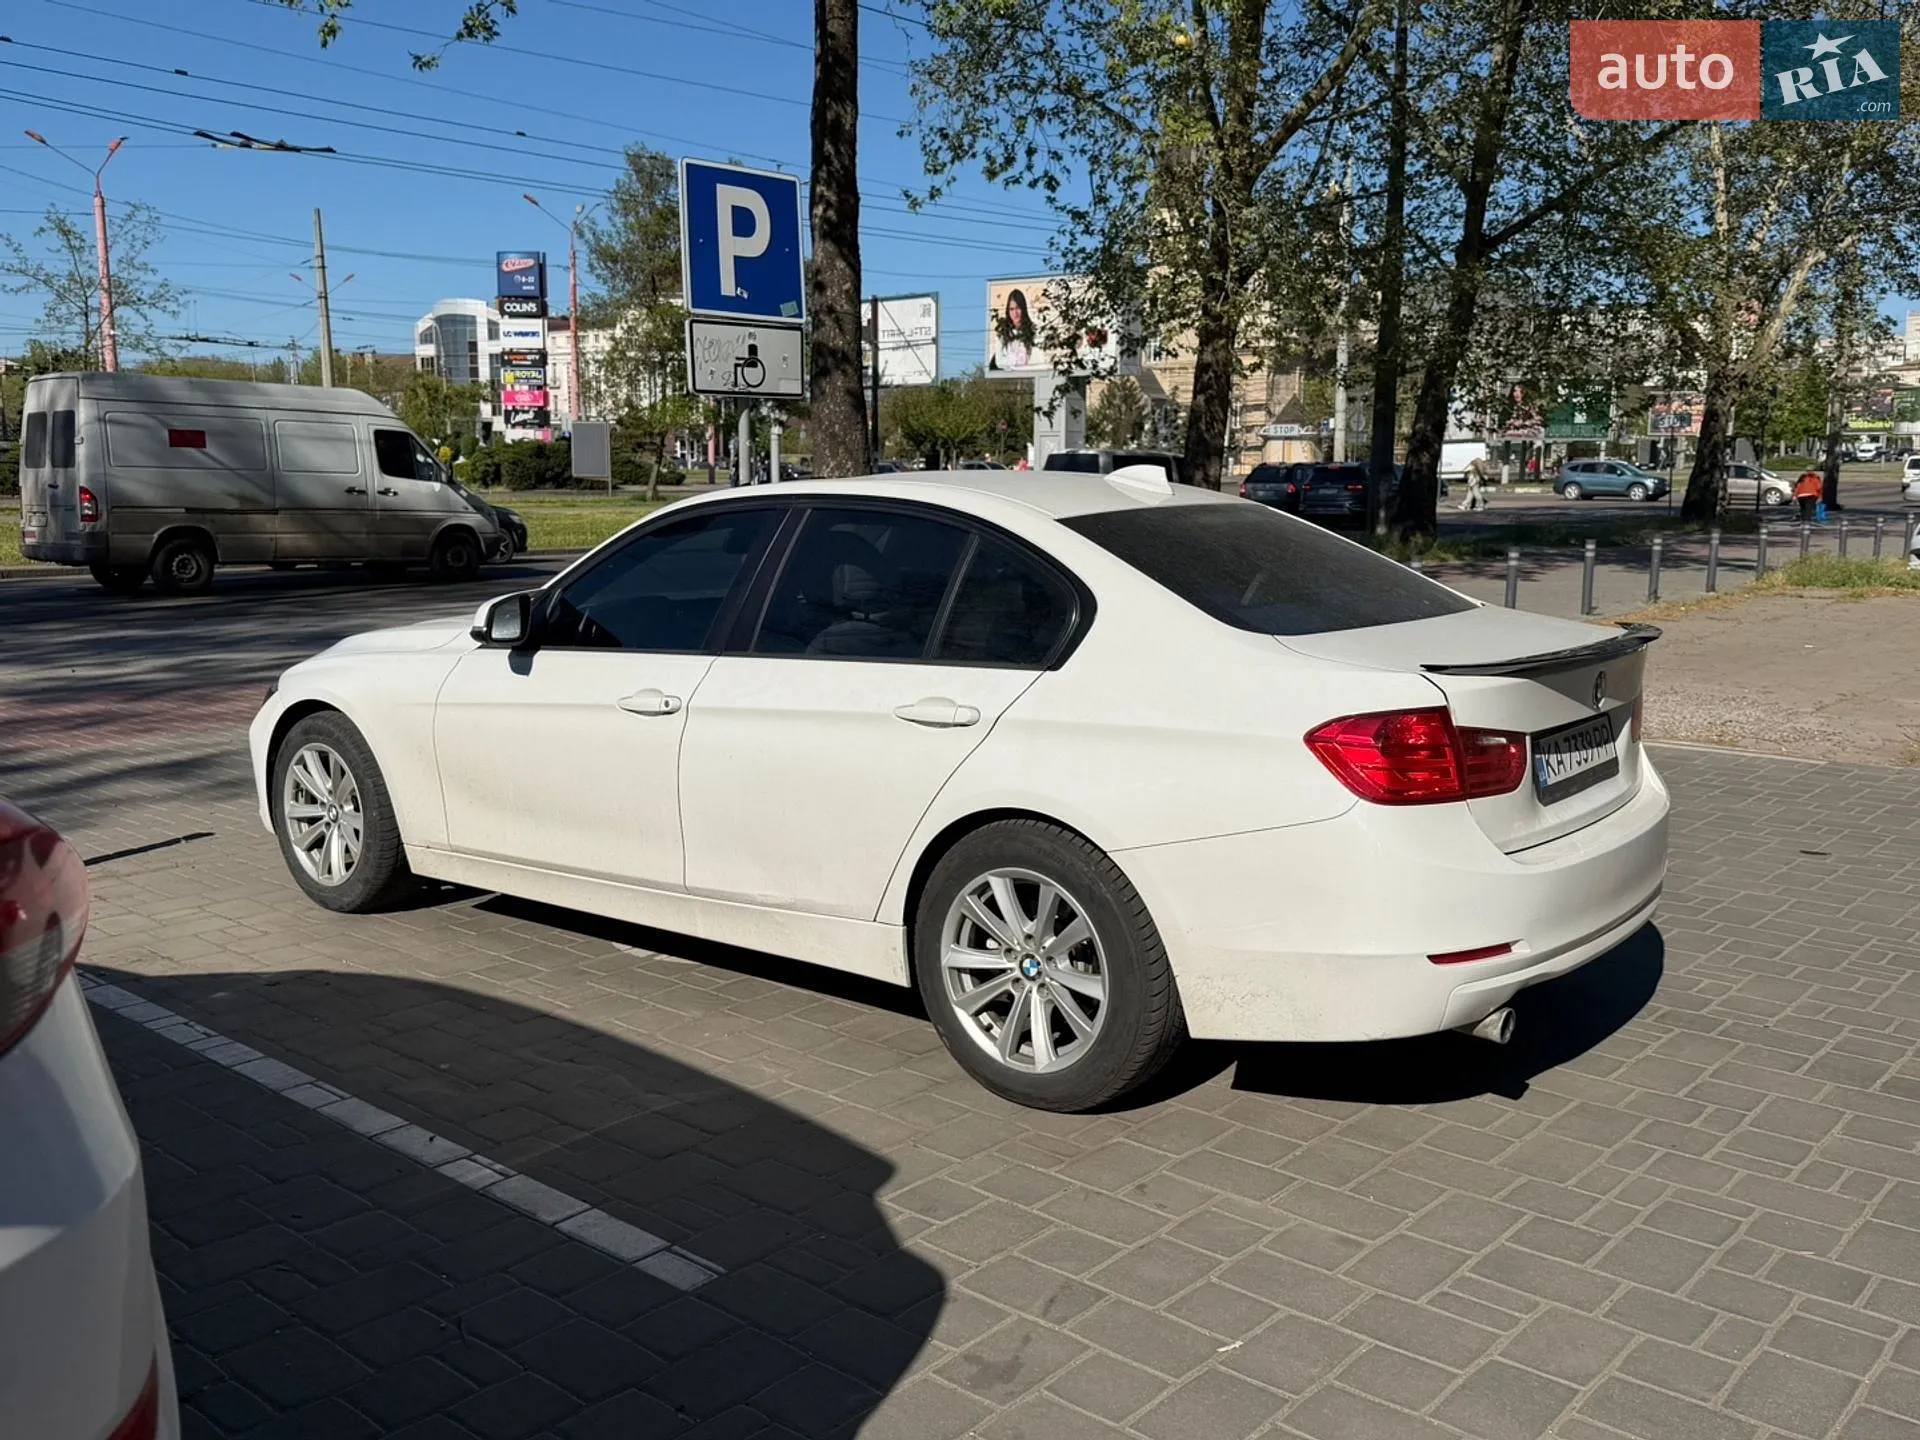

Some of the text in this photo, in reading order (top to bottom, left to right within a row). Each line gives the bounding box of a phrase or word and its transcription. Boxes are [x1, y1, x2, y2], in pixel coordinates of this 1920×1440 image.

[716, 183, 771, 297] P
[503, 302, 538, 312] COLIN'S
[1273, 426, 1296, 434] STOP
